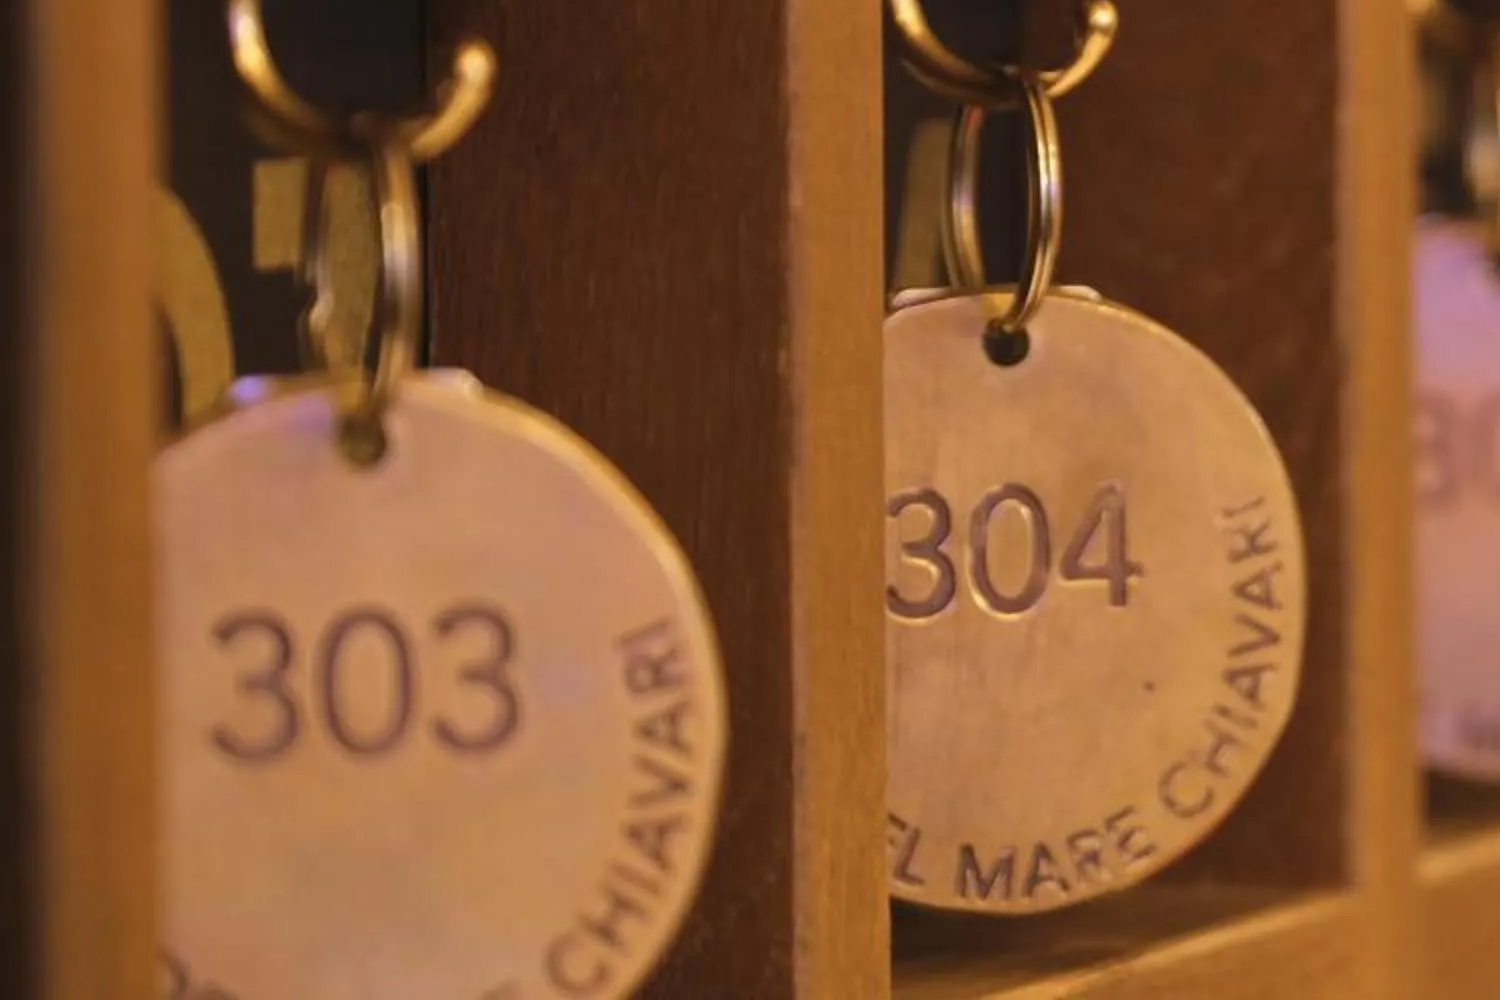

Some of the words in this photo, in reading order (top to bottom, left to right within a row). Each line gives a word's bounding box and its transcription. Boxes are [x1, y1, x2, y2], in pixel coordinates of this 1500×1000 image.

[885, 482, 1146, 622] 304
[207, 602, 524, 766] 303
[542, 616, 698, 998] CHIAVARI
[955, 803, 1157, 901] MARE
